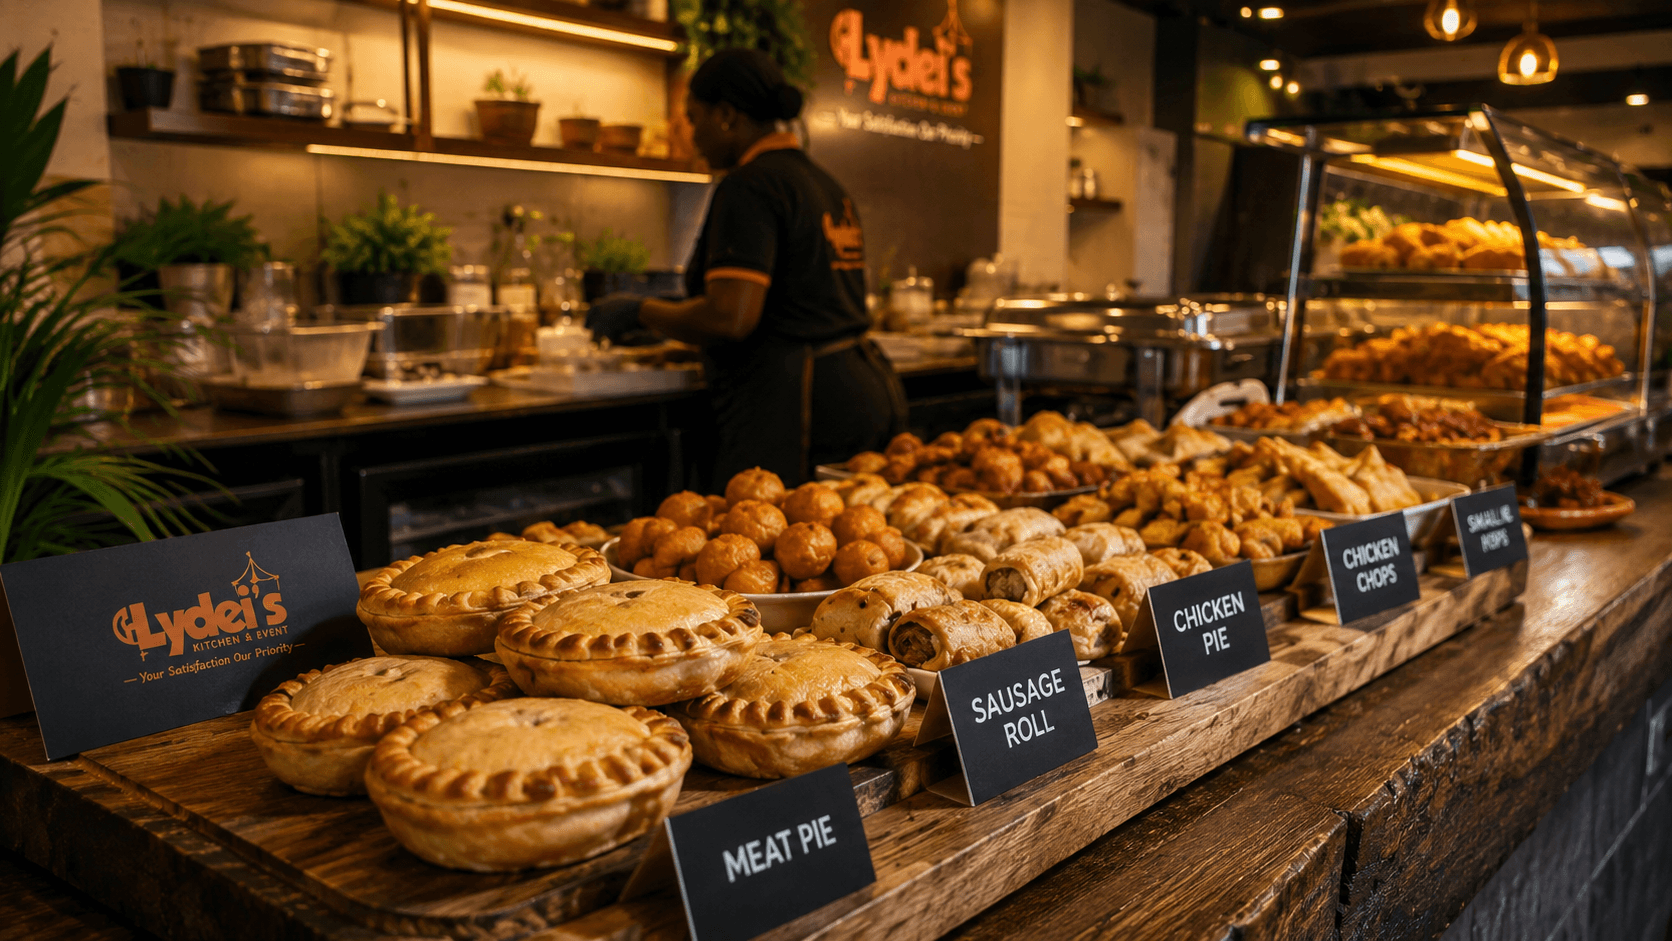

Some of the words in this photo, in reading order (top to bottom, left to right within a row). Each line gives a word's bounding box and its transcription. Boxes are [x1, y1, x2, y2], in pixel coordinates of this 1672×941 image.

[1342, 536, 1399, 570] CHICKEN
[1356, 563, 1398, 593] CHOPS
[1173, 591, 1245, 633] CHICKEN
[193, 635, 241, 653] KITCHEN
[245, 633, 253, 642] &
[256, 625, 289, 640] EVENT
[1202, 626, 1231, 655] PIE
[138, 670, 165, 684] Your
[168, 656, 231, 676] Satisfaction
[233, 651, 252, 662] Our
[255, 642, 293, 658] Priority
[971, 668, 1066, 724] SAUSAGE
[1003, 709, 1055, 749] ROLL
[722, 828, 793, 883] MEAT
[797, 814, 838, 855] PIE
